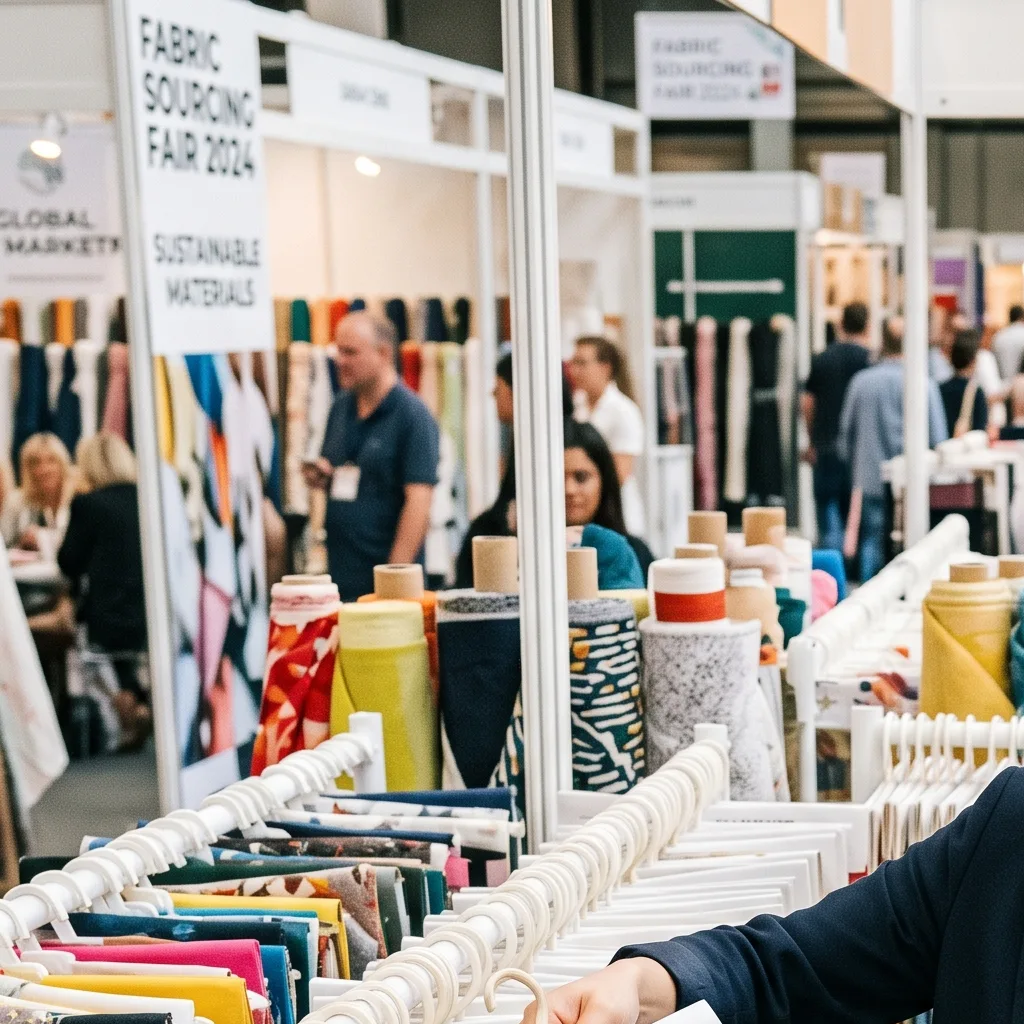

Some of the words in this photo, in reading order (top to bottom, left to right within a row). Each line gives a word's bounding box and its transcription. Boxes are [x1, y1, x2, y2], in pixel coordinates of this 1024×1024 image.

[140, 15, 220, 73] FABRIC
[143, 71, 254, 129] SOURCING
[148, 124, 199, 171] FAIR
[205, 133, 256, 178] 2024
[153, 233, 260, 268] SUSTAINABLE
[166, 276, 256, 308] MATERIALS
